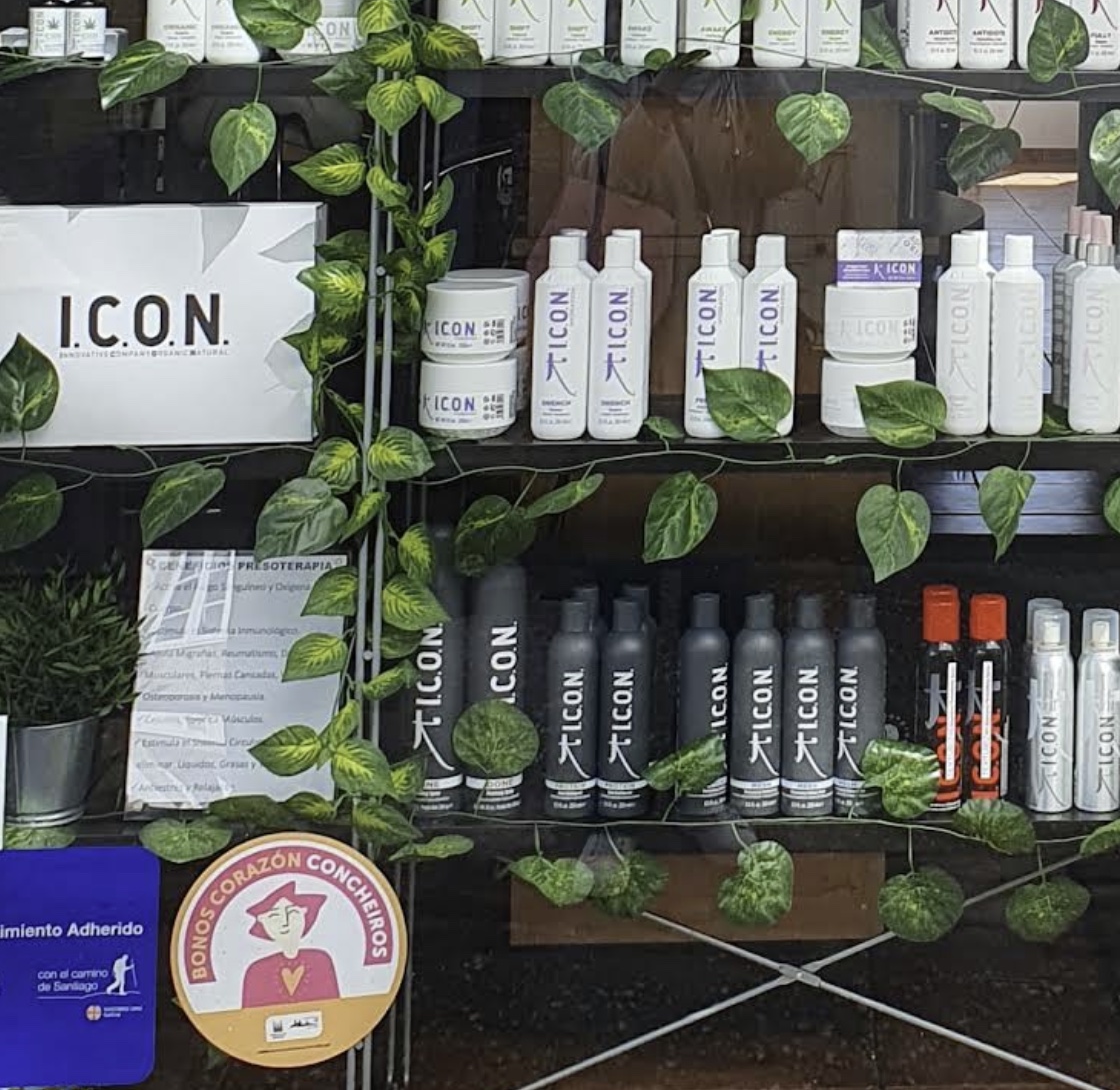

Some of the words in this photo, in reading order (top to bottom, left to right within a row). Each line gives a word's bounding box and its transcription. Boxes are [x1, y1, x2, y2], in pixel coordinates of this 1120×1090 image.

[60, 293, 230, 348] I.C.O.N.
[192, 907, 216, 981] BONOS
[210, 850, 300, 906] CORAZÓN
[306, 854, 387, 959] CONCHEIROS
[67, 922, 143, 937] Adherido
[38, 970, 57, 980] con
[60, 969, 69, 979] el
[71, 969, 109, 979] camino
[37, 982, 51, 992] de
[53, 981, 98, 993] Santiago
